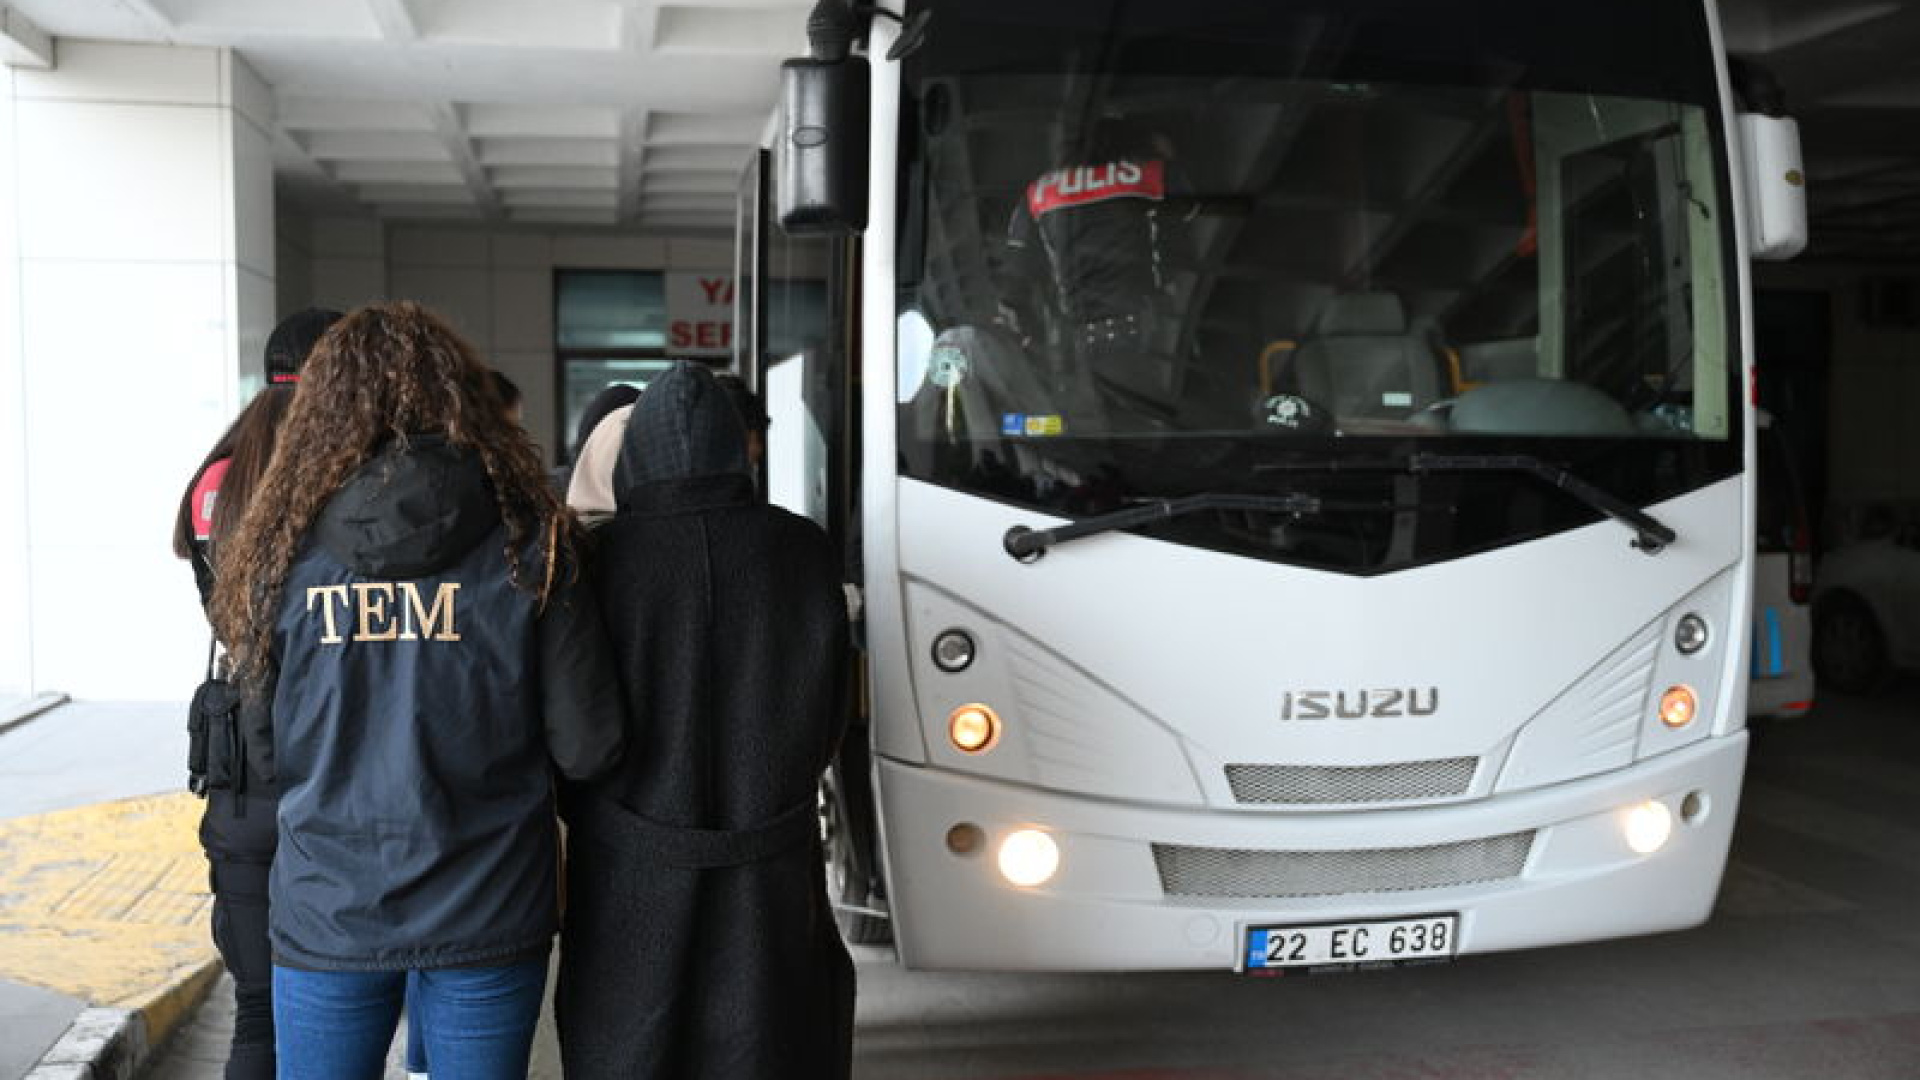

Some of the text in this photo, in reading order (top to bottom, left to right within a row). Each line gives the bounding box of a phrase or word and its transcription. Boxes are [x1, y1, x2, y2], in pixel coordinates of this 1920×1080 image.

[306, 582, 462, 644] TEM
[1281, 686, 1438, 720] ISUZU
[1267, 933, 1306, 961] 22
[1330, 928, 1369, 959] EC
[1389, 921, 1447, 954] 638
